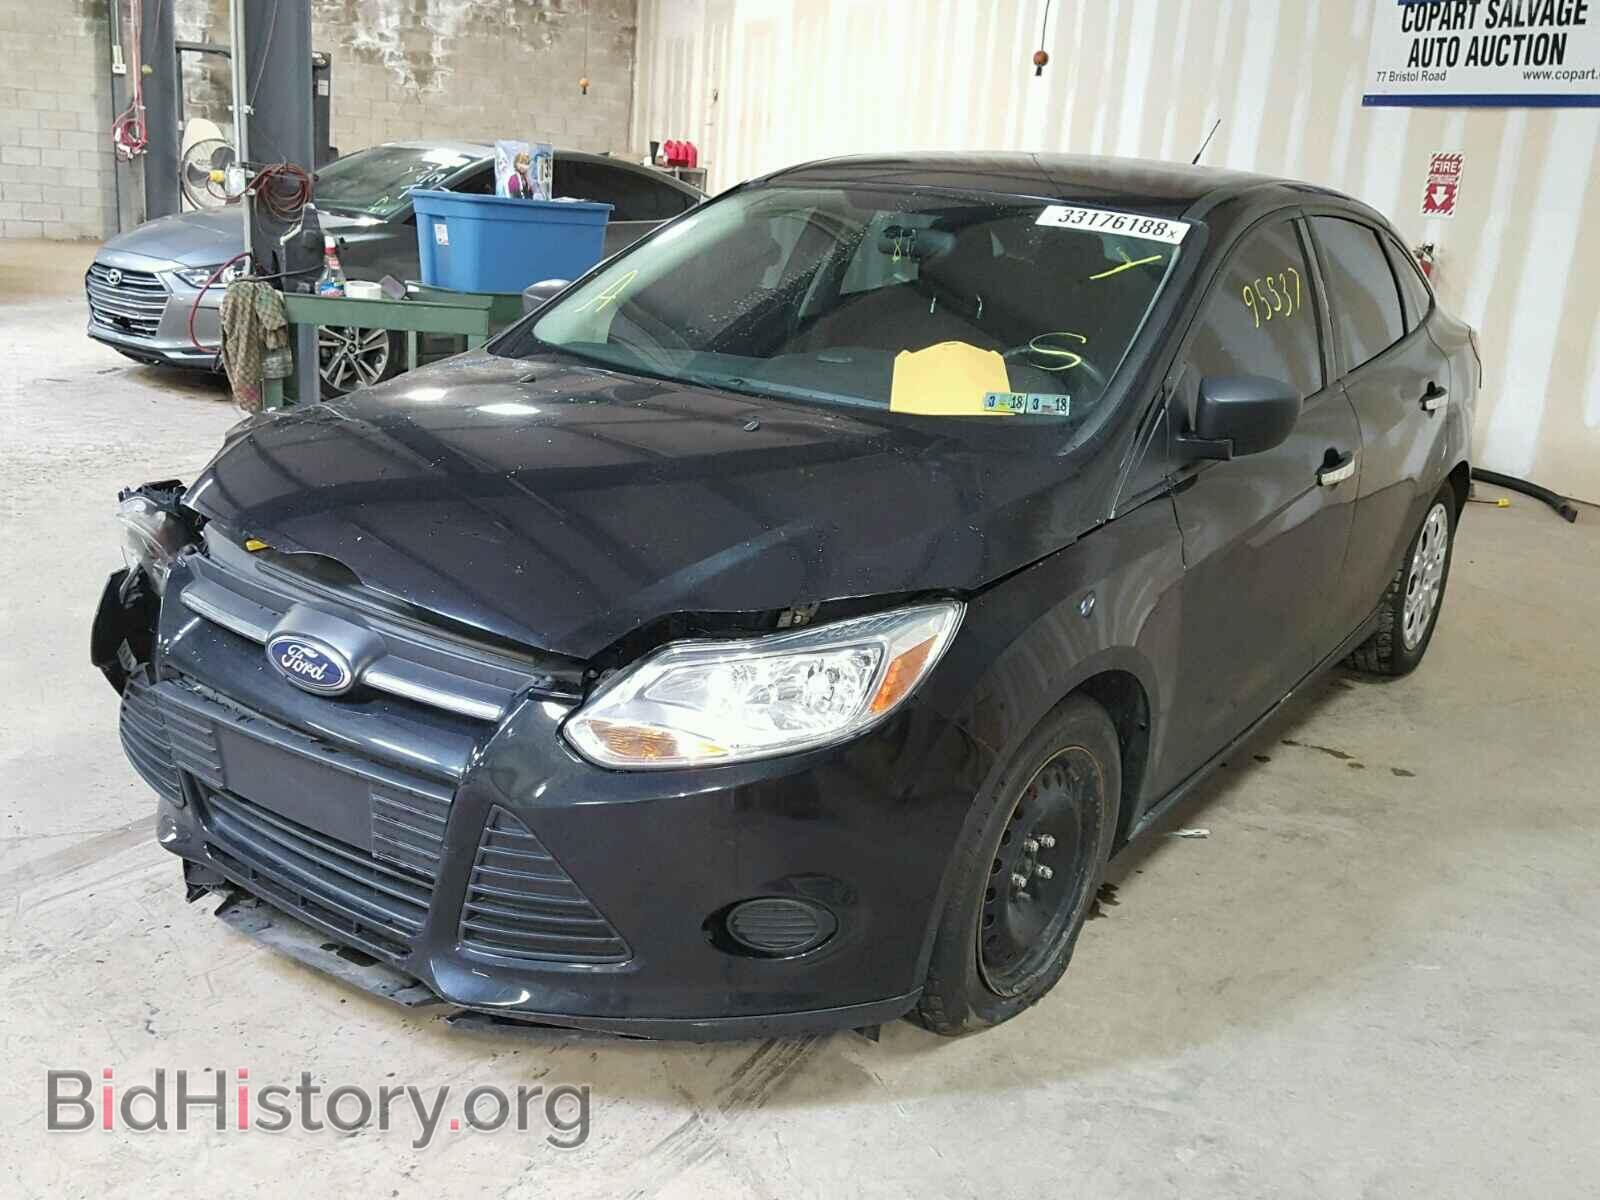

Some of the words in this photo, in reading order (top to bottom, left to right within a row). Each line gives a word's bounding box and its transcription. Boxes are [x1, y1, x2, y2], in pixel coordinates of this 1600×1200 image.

[1401, 1, 1480, 32] COPART
[1485, 0, 1588, 29] SALVAGE
[1407, 36, 1461, 68] AUTO
[1464, 33, 1567, 66] AUCTION
[1377, 71, 1387, 82] 77
[1389, 70, 1419, 82] Bristol
[1421, 69, 1447, 81] Road
[1433, 161, 1459, 173] FIRE
[1010, 395, 1023, 409] 18
[1032, 398, 1040, 410] 3
[1055, 398, 1067, 411] 18
[281, 645, 329, 680] Ford
